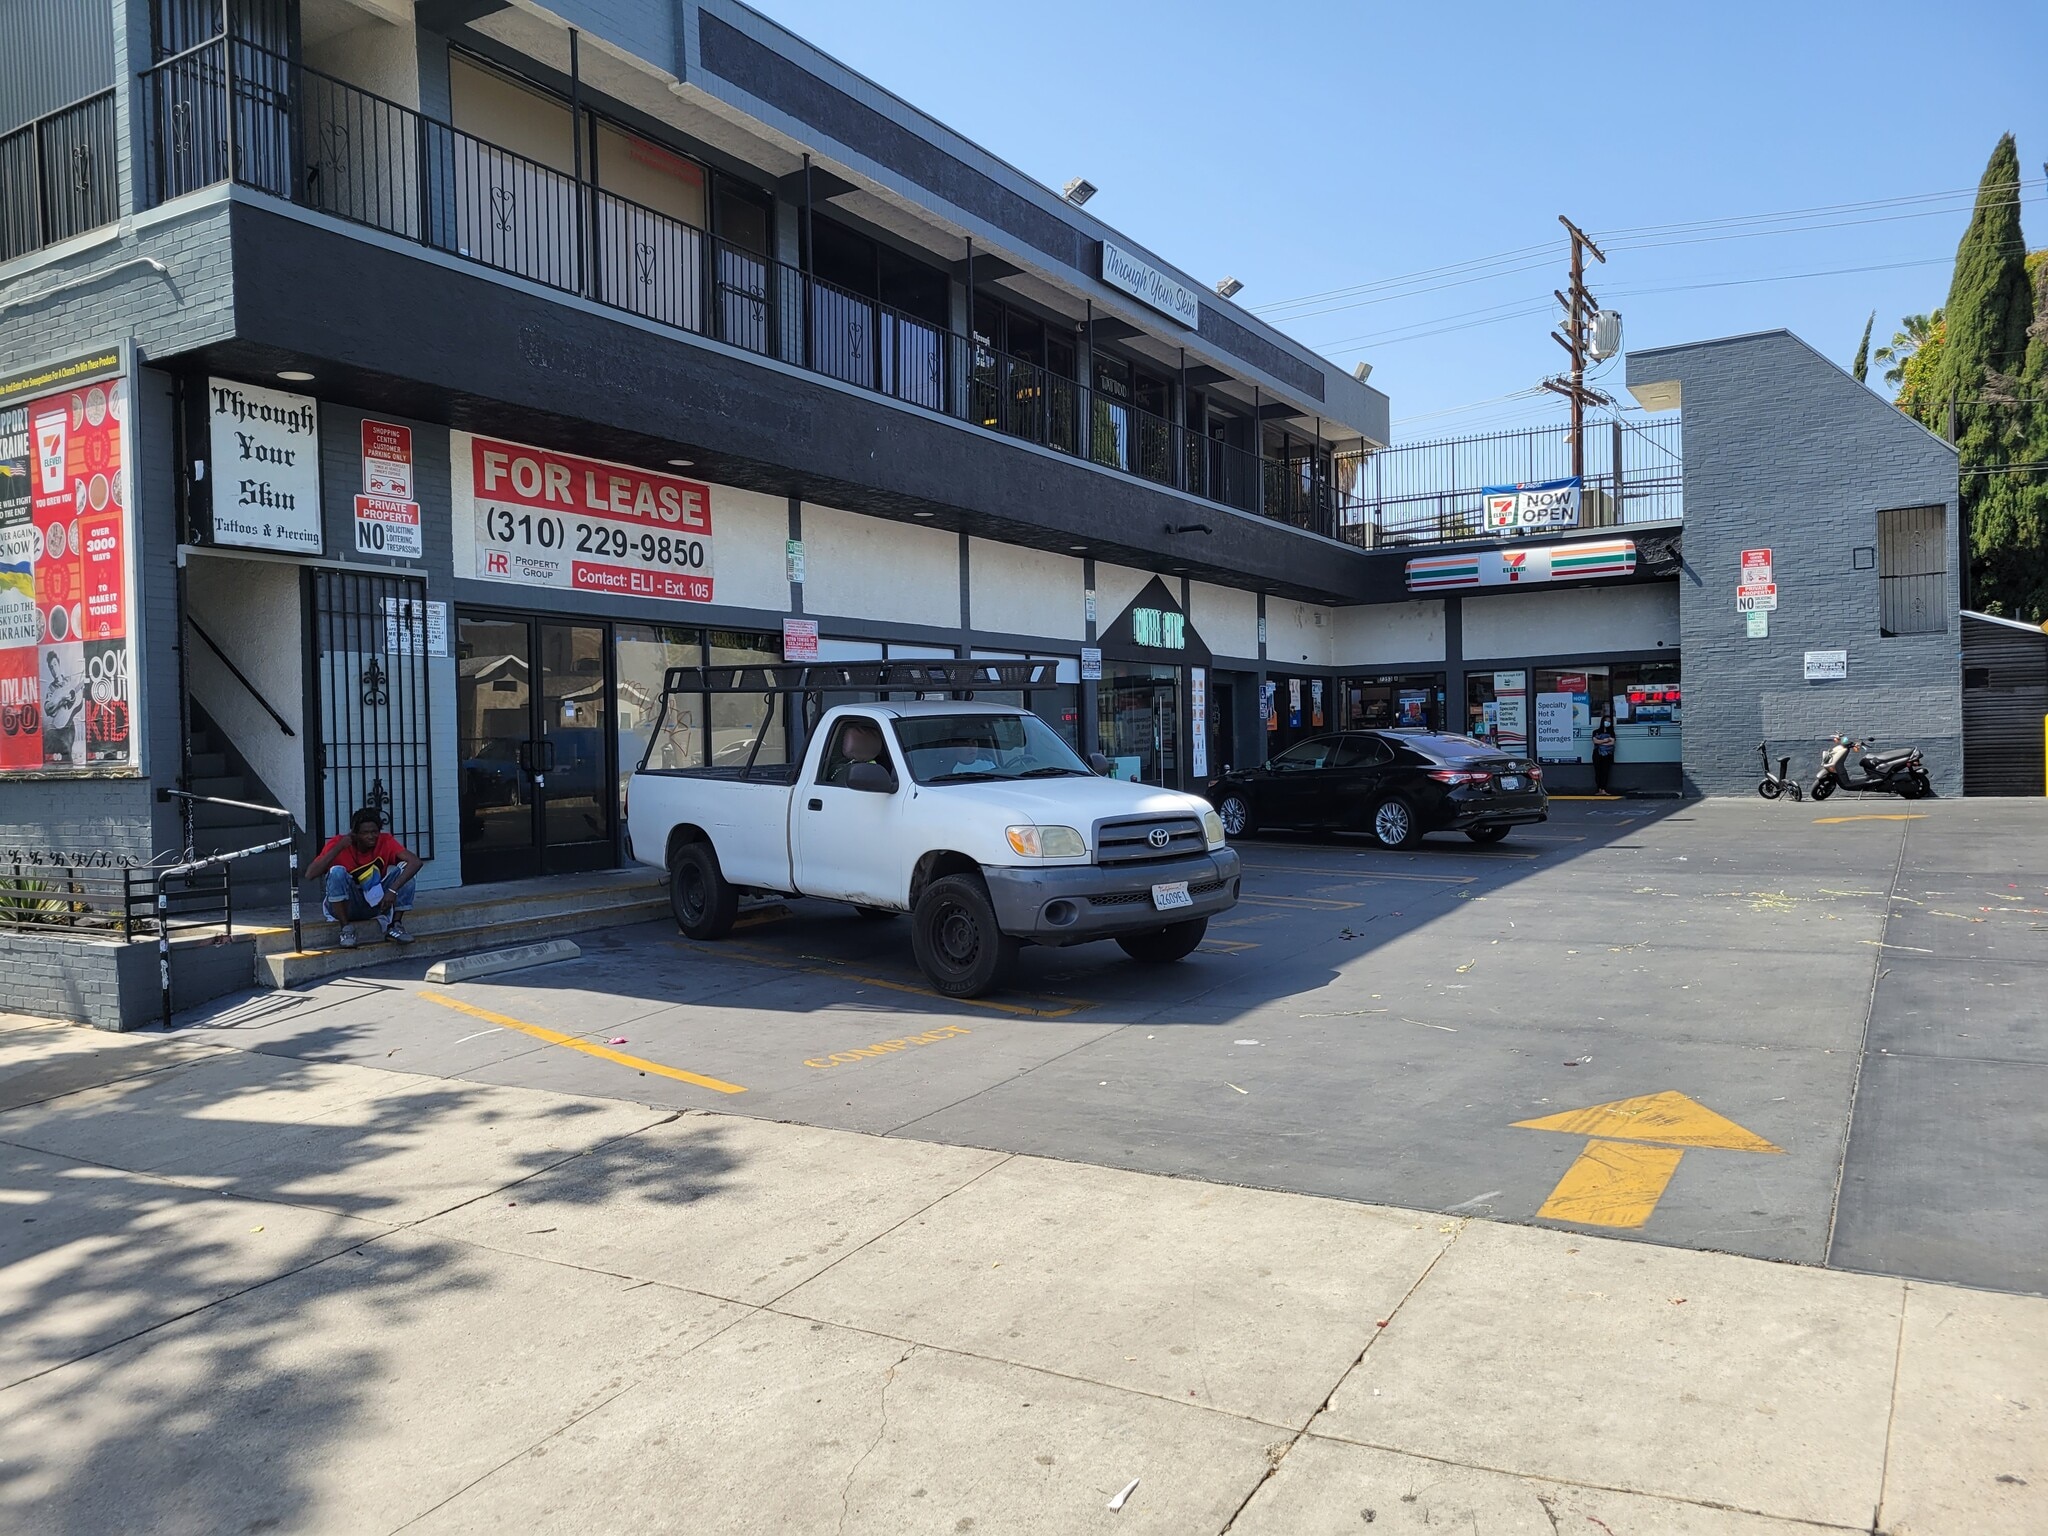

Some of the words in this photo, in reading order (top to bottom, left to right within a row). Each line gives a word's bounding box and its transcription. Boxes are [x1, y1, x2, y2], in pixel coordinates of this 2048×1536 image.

[1106, 244, 1147, 294] Through
[1149, 270, 1173, 307] Your
[1175, 287, 1195, 319] Skin
[62, 366, 75, 377] Chance
[75, 364, 80, 374] To
[99, 355, 117, 367] Products
[211, 386, 314, 436] Through
[372, 426, 400, 438] SHOPPING
[376, 435, 397, 445] CENTER
[234, 431, 296, 467] Your
[373, 442, 401, 453] CUSTOMER
[367, 449, 391, 459] PARKING
[392, 453, 407, 462] ONLY
[238, 479, 295, 511] Skin
[483, 450, 574, 505] FOR
[585, 471, 704, 527] LEASE
[3, 498, 15, 509] WILL
[16, 496, 31, 504] FIGHT
[36, 499, 46, 508] YOU
[47, 497, 61, 506] BREW
[62, 494, 72, 503] YOU
[368, 499, 407, 513] PRIVATE
[1527, 492, 1571, 507] NOW
[5, 509, 14, 518] THE
[363, 508, 413, 523] PROPERTY
[1523, 507, 1573, 522] OPEN
[12, 527, 33, 539] AGAIN
[91, 527, 109, 537] OVER
[214, 517, 258, 536] Tattoos
[263, 523, 272, 537] &
[276, 524, 320, 546] Piercing
[359, 521, 385, 550] NO
[385, 525, 414, 535] SOLICITING
[86, 537, 116, 552] 3000
[386, 534, 412, 544] LOITERING
[487, 507, 565, 550] (310)
[576, 523, 704, 568] 229-9850
[7, 540, 31, 556] NOW
[386, 544, 420, 554] TRESPASSING
[92, 552, 110, 561] WAYS
[98, 584, 107, 592] TO
[577, 568, 627, 588] Contact:
[630, 573, 654, 592] ELI
[665, 581, 687, 596] Ext.
[689, 582, 709, 599] 105
[89, 594, 109, 604] MAKE
[109, 593, 117, 601] IT
[1739, 597, 1754, 610] NO
[21, 602, 34, 611] THE
[89, 604, 117, 615] YOURS
[14, 614, 33, 624] OVER
[84, 649, 128, 684] LOOK
[1, 676, 38, 706] DYLAN
[86, 700, 129, 743] KID
[1538, 735, 1571, 743] Beverages
[803, 1025, 972, 1069] COMPACT
